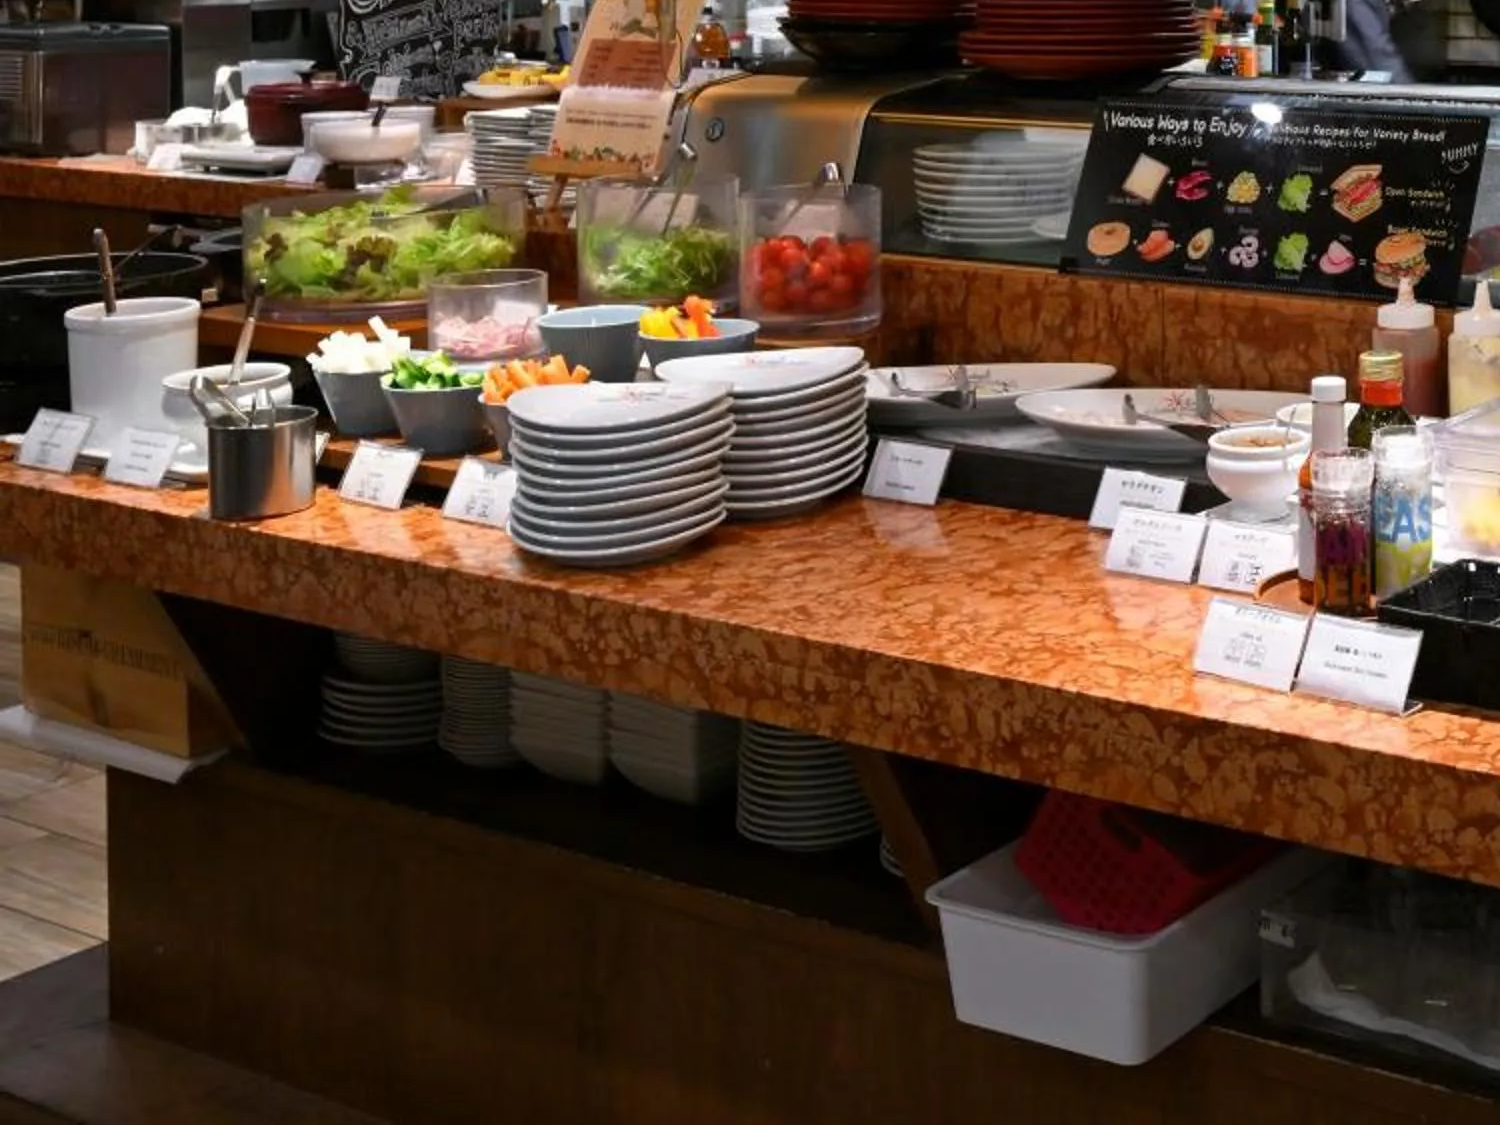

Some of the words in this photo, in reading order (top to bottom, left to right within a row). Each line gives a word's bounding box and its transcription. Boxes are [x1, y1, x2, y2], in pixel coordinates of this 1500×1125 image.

[1111, 110, 1154, 129] Various
[1157, 114, 1190, 134] Ways
[1193, 116, 1207, 133] to
[1209, 116, 1248, 138] Enjoy
[1313, 124, 1351, 140] Recipes
[1372, 127, 1410, 145] Variety
